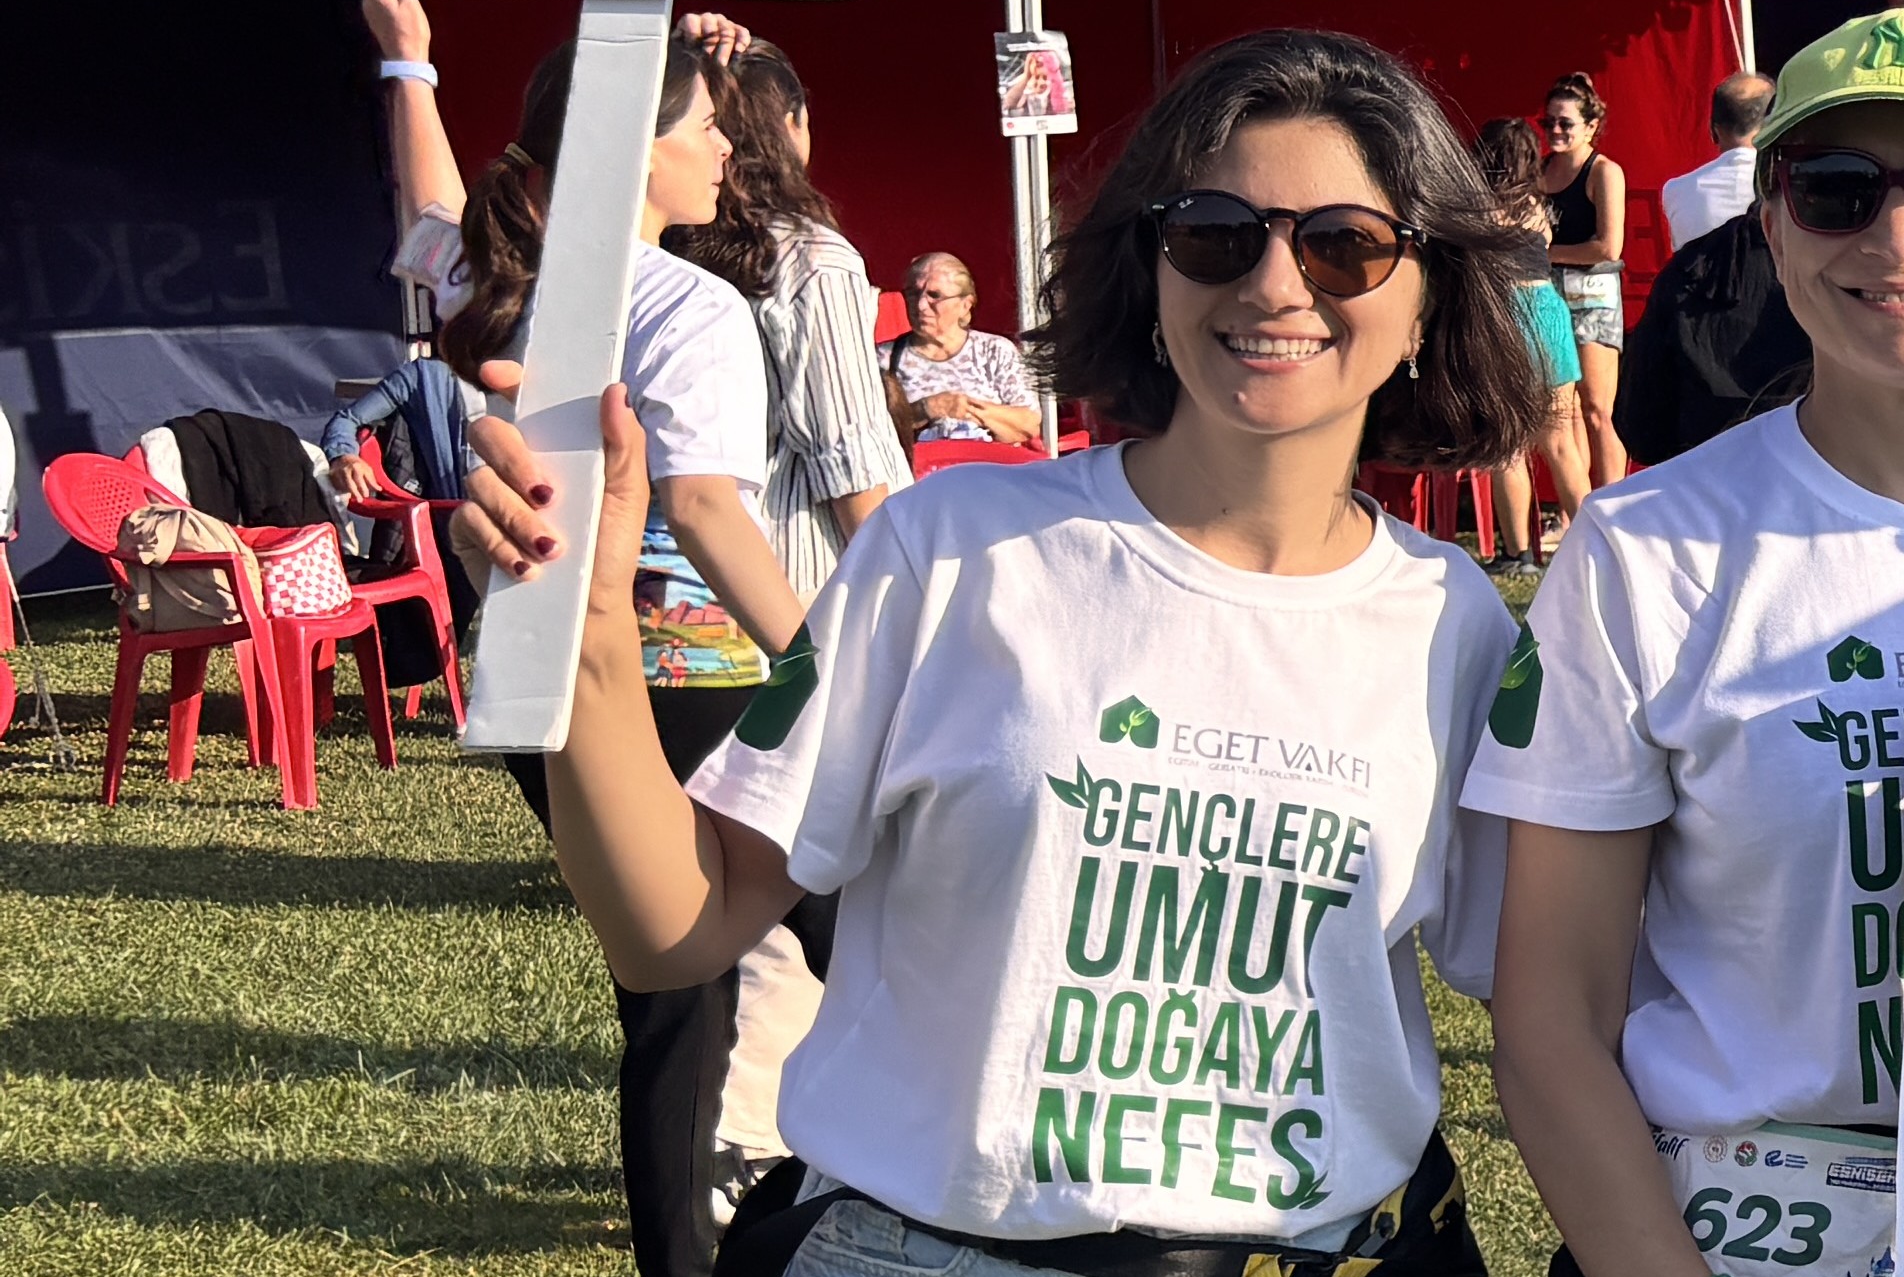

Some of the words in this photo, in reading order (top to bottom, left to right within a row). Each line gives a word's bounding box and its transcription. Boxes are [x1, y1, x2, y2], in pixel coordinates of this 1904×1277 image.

[1172, 724, 1269, 764] EGET
[1279, 739, 1370, 788] VAKFI
[1083, 778, 1371, 884] GENÇLERE
[1066, 857, 1352, 998] UMUT
[1043, 986, 1325, 1096] DOĞAYA
[1032, 1087, 1324, 1211] NEFES
